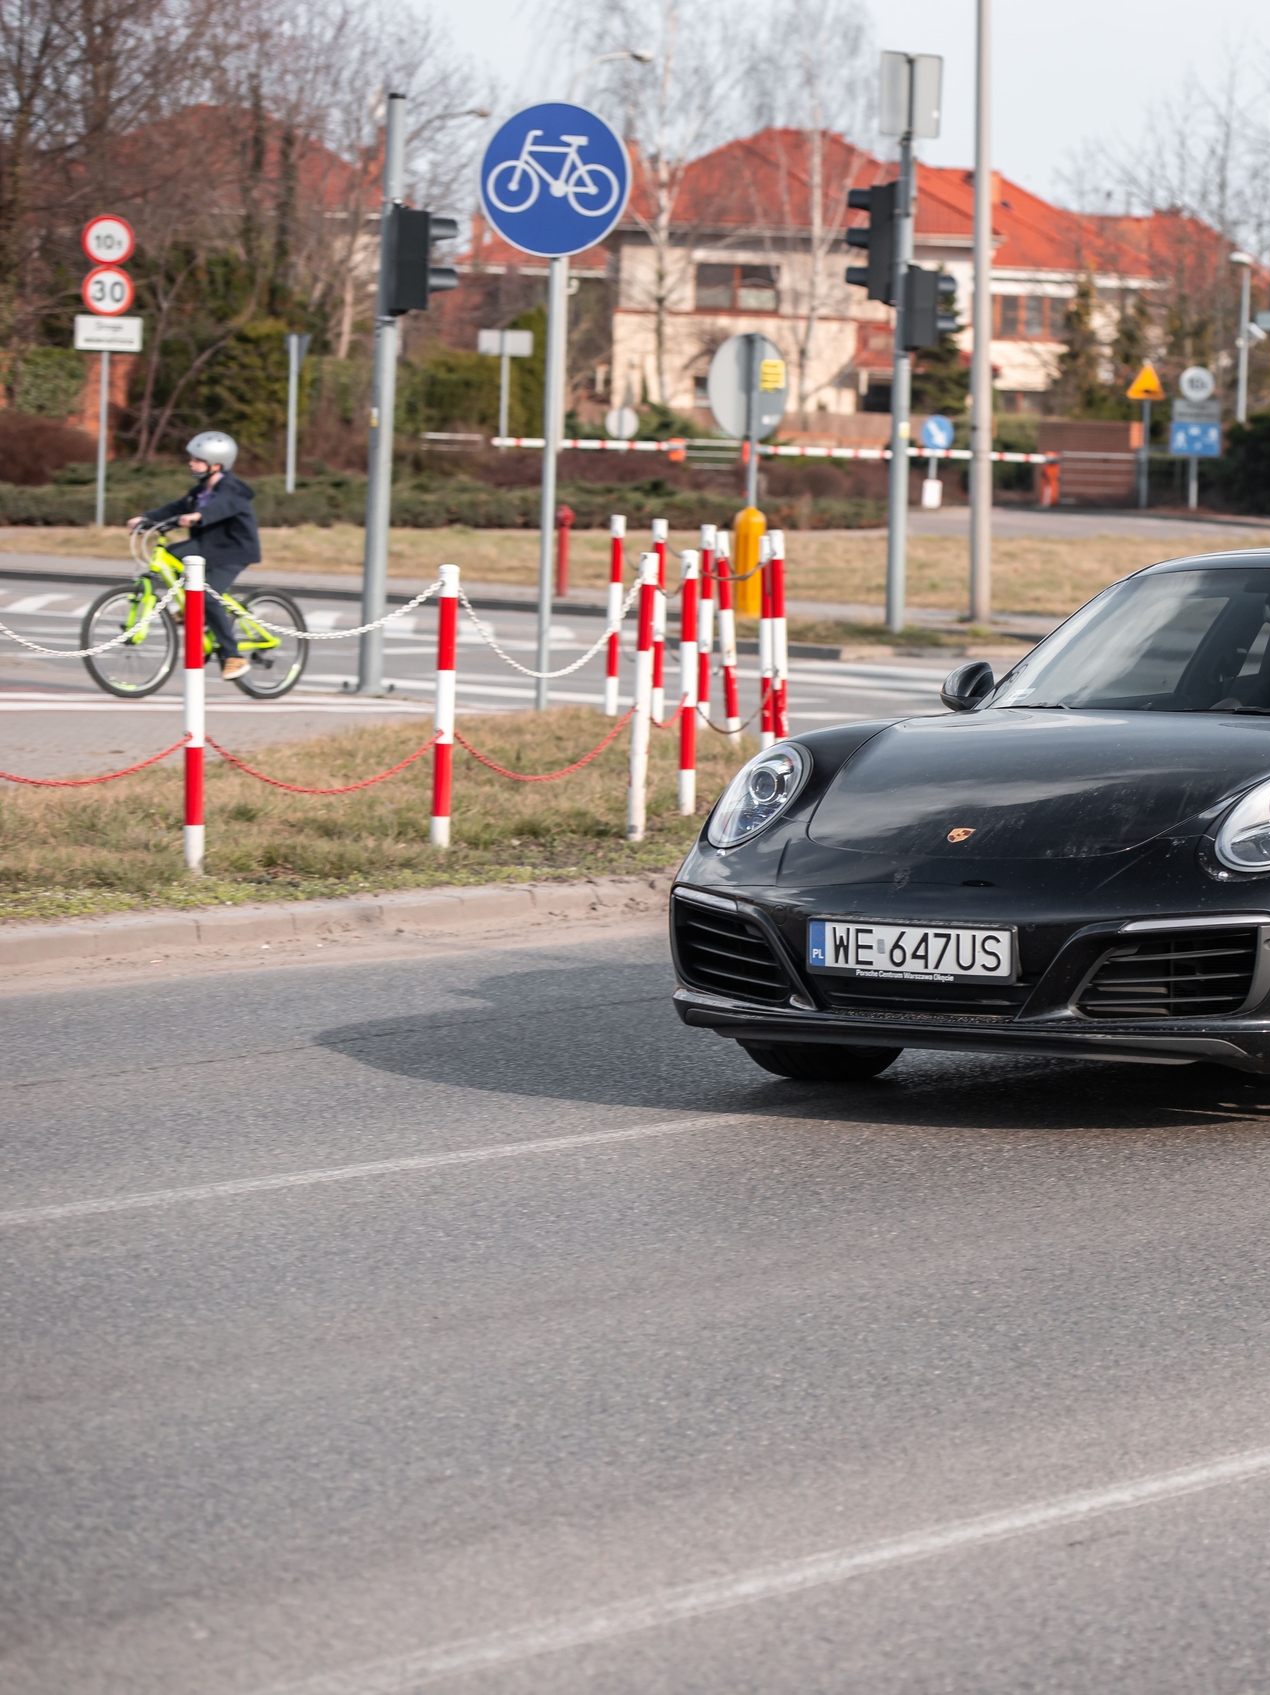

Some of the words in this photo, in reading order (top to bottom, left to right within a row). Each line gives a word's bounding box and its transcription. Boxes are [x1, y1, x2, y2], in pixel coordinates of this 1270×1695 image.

[92, 280, 125, 302] 30
[812, 948, 824, 960] PL
[832, 926, 874, 966] WE
[889, 930, 1003, 973] 647US
[856, 969, 878, 977] Porsche
[879, 970, 903, 978] Centrum
[903, 972, 933, 980] Warszawa
